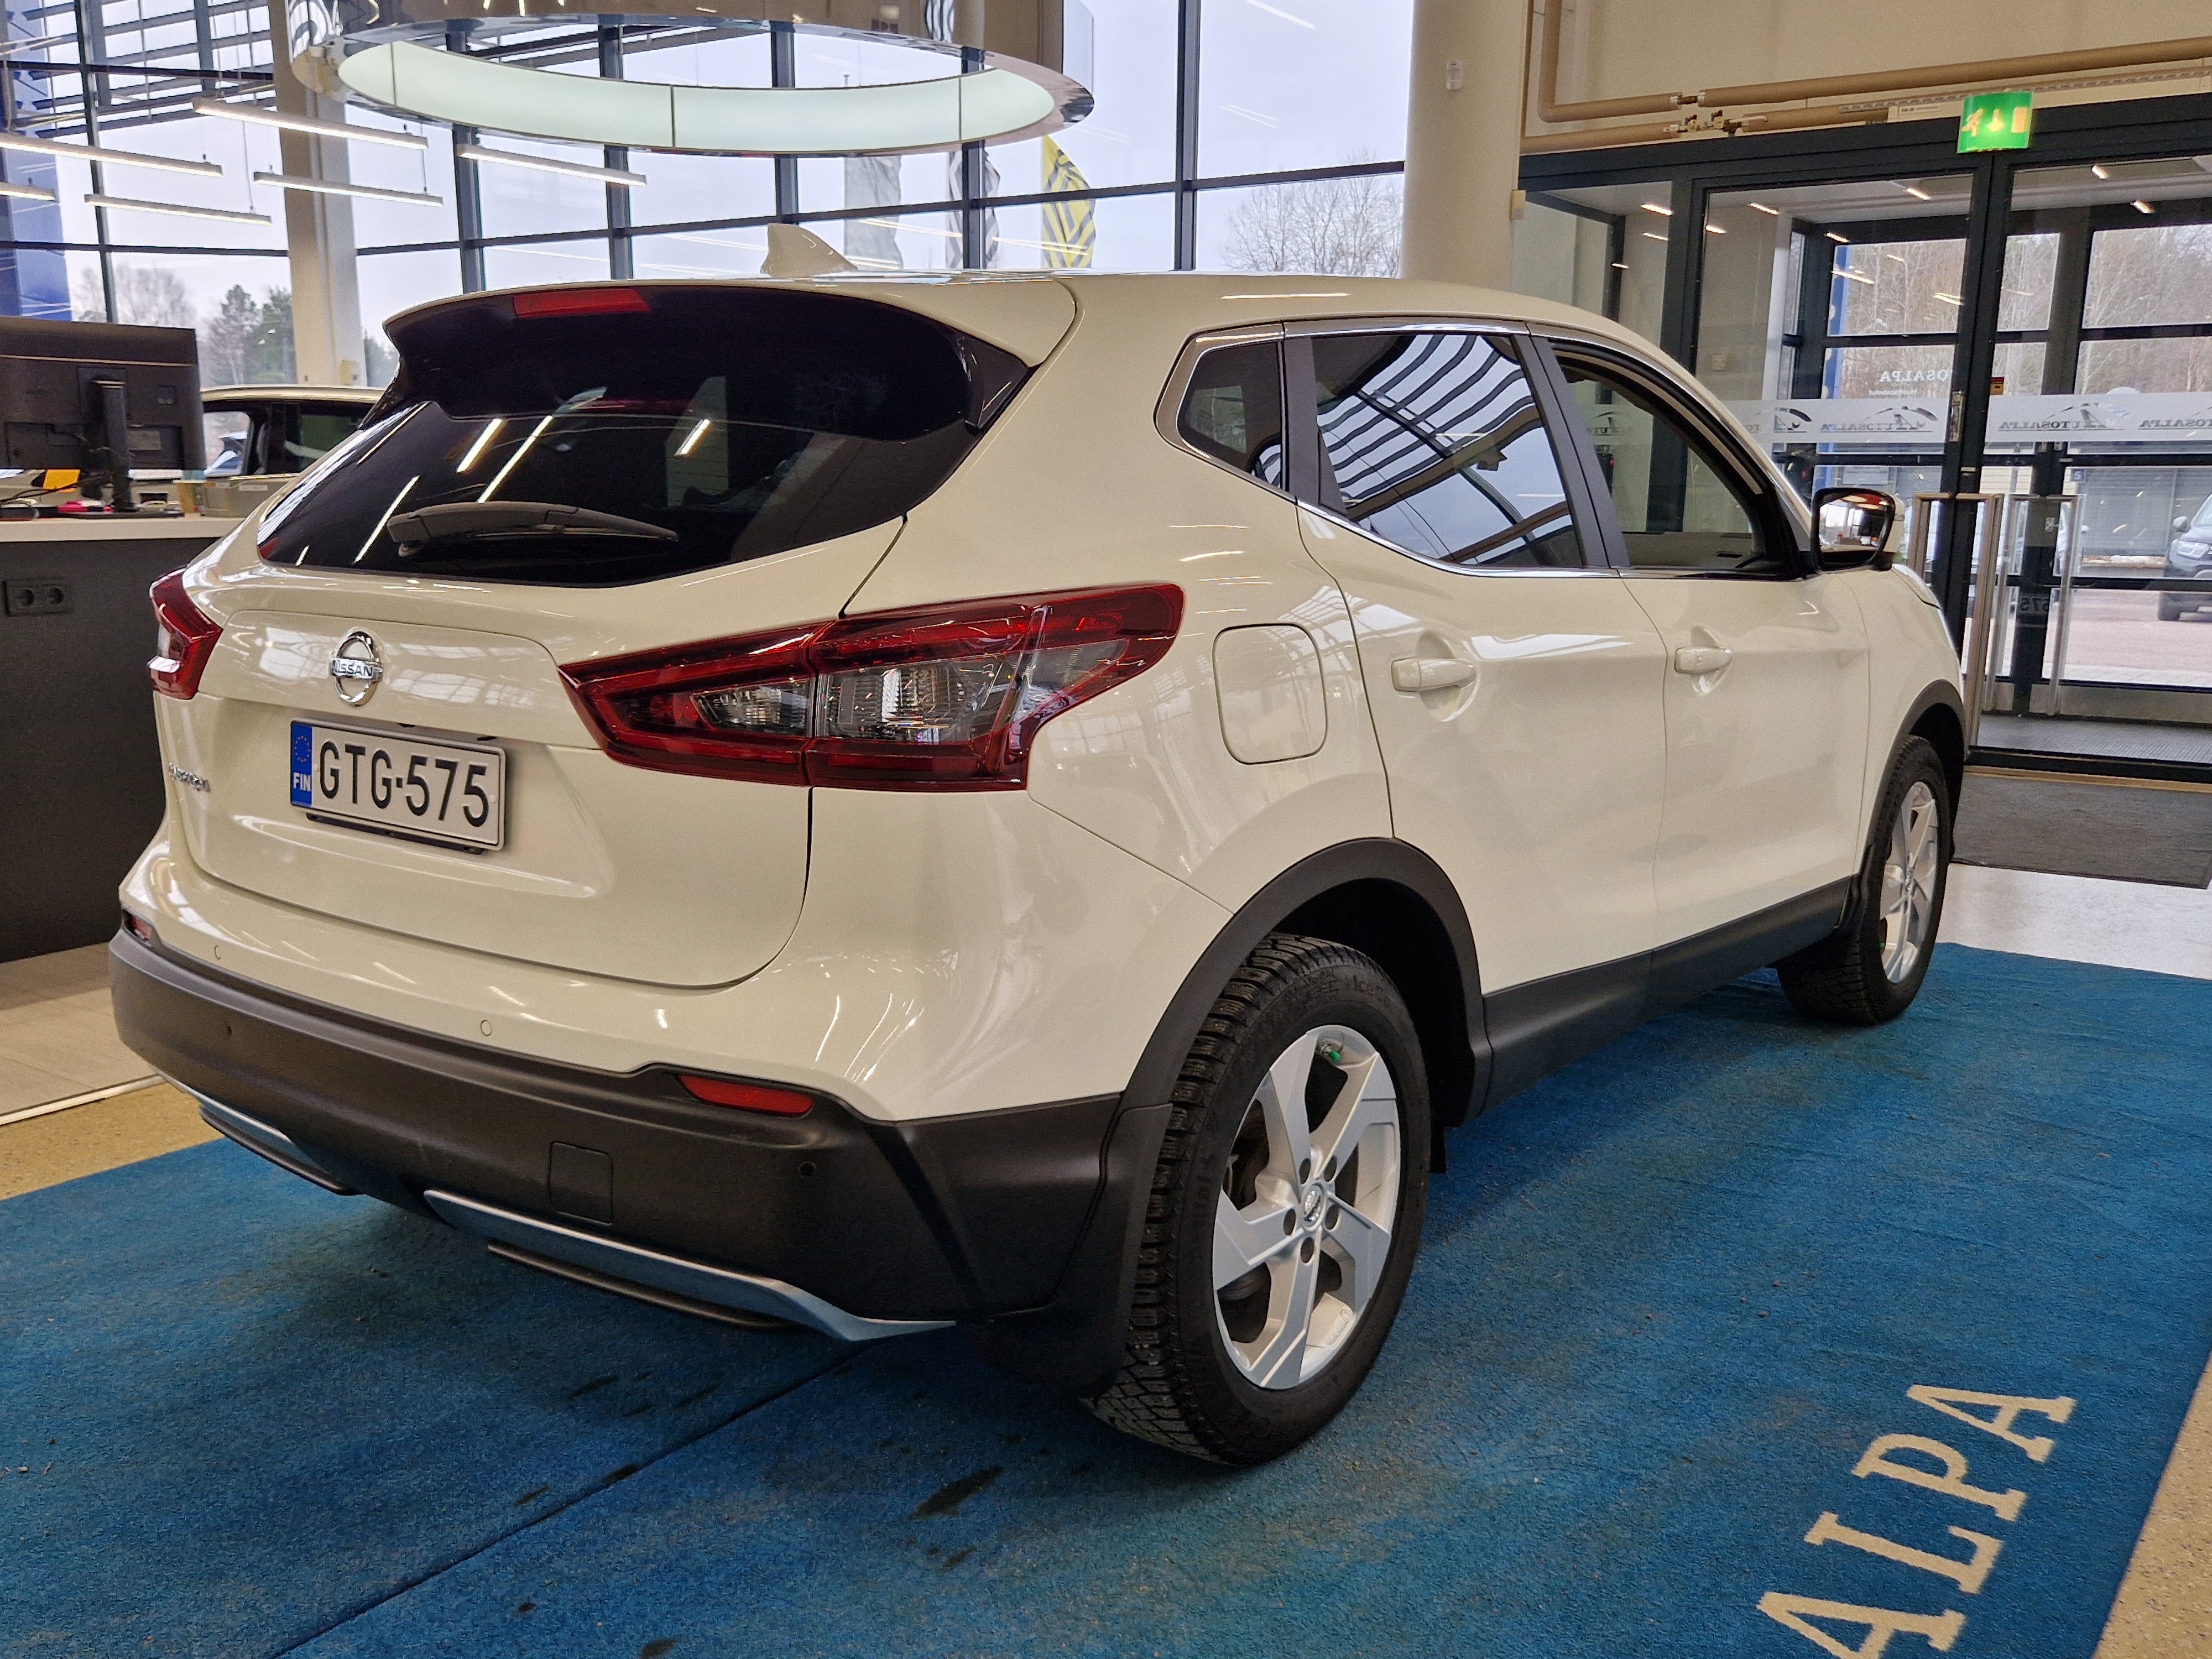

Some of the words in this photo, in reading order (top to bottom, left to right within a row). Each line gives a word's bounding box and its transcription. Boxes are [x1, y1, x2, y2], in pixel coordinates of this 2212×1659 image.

[2074, 471, 2081, 481] 5
[332, 659, 373, 677] NISSAN
[293, 772, 311, 792] FIN
[320, 740, 489, 827] GTG-575
